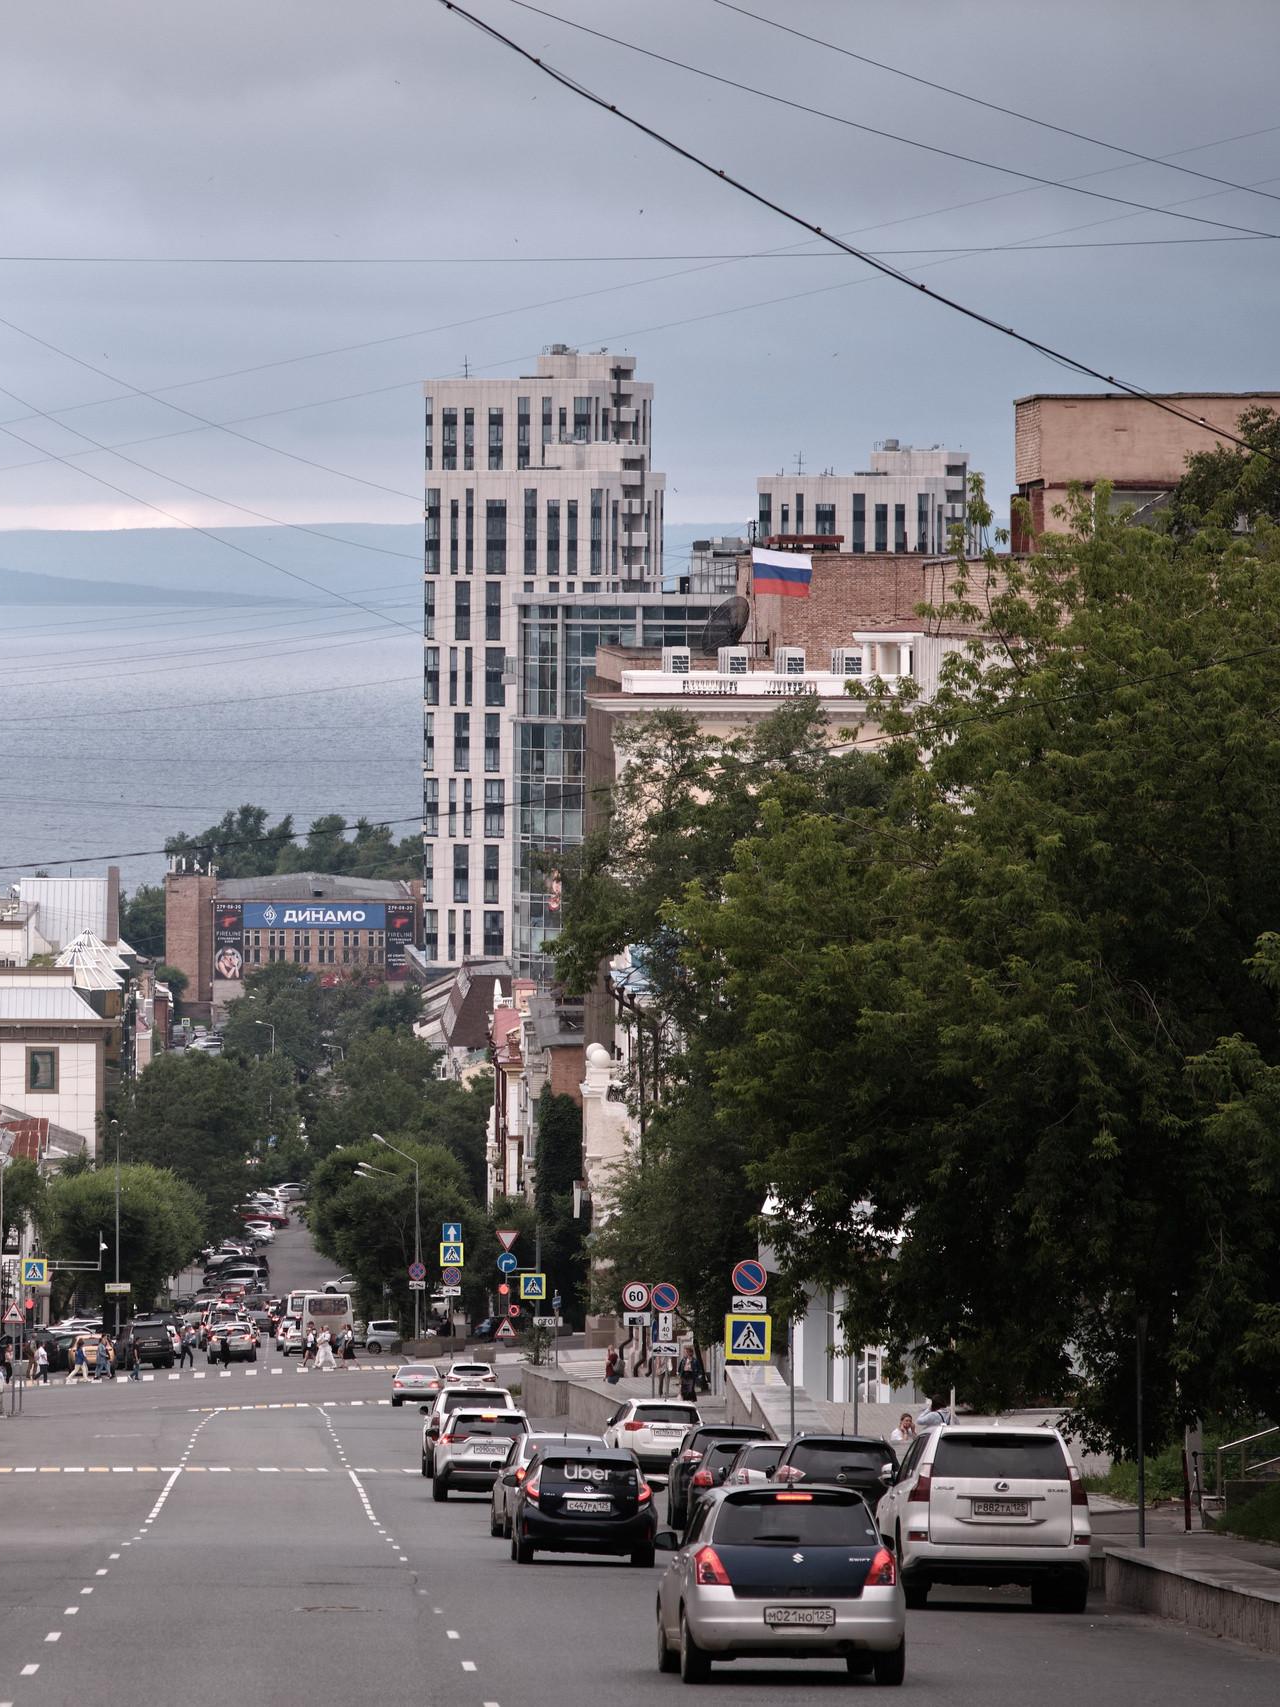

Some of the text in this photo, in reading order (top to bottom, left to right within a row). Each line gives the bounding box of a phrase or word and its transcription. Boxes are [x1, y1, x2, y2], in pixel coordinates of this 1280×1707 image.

[283, 910, 366, 923] ДИНАМО
[629, 1291, 644, 1302] 60
[564, 1464, 612, 1481] Uber
